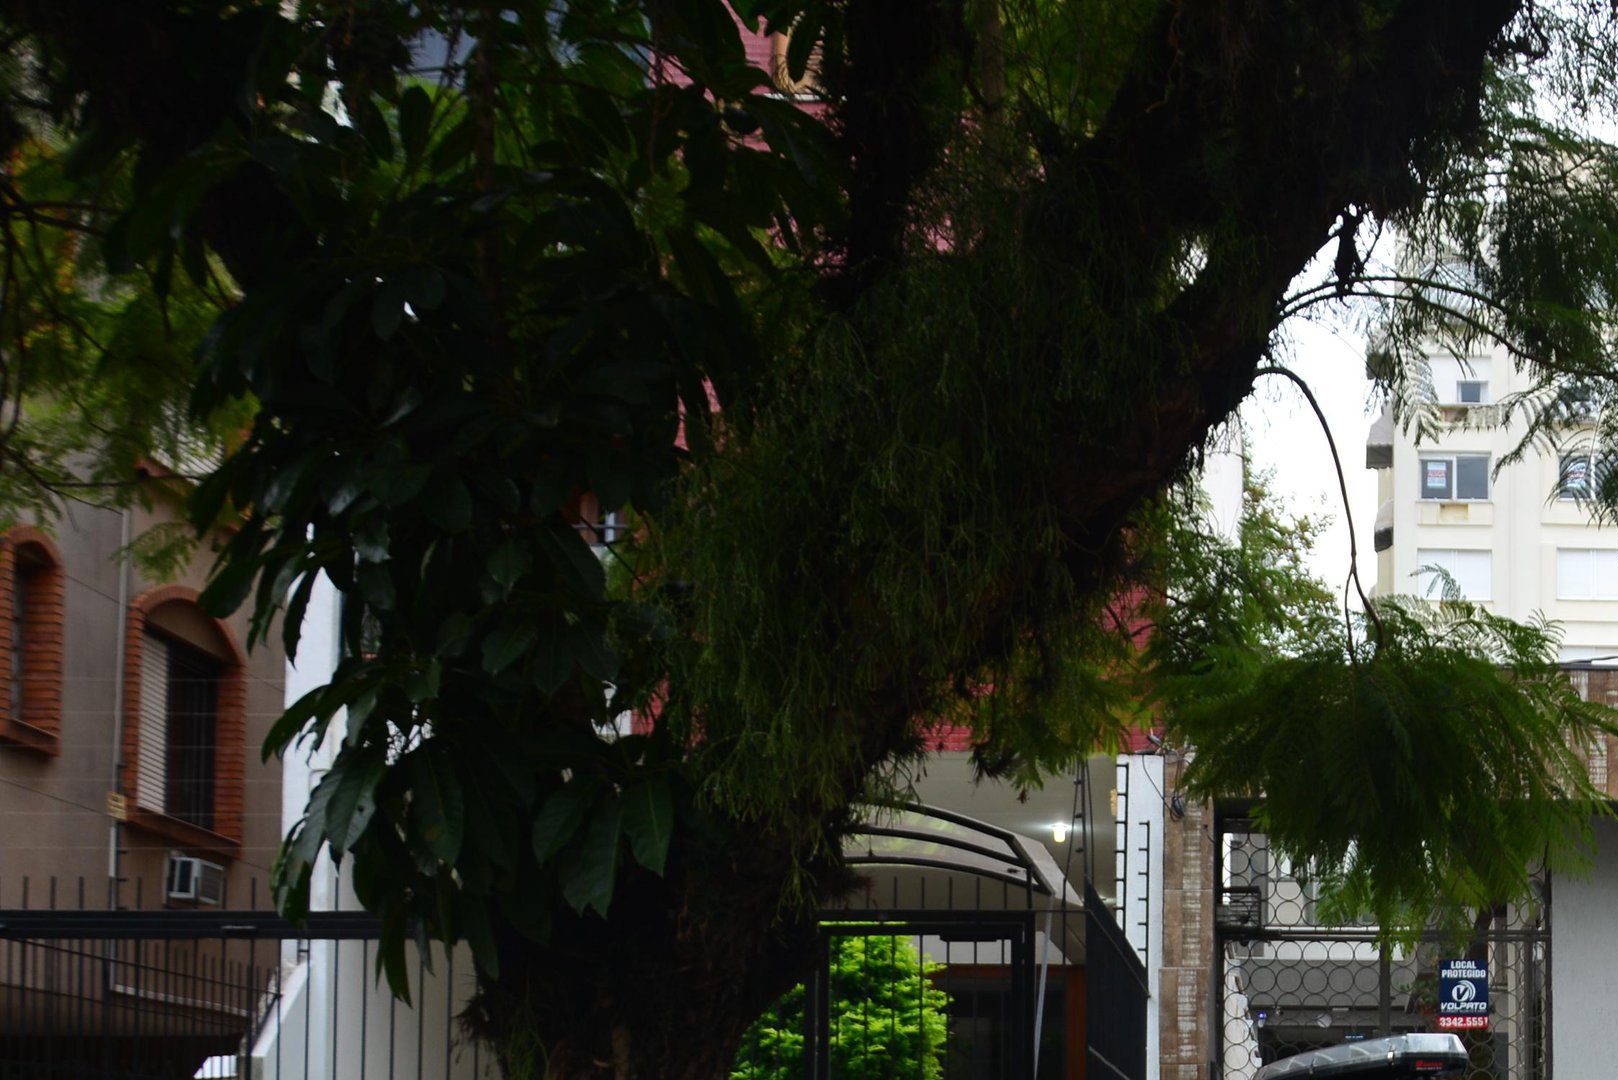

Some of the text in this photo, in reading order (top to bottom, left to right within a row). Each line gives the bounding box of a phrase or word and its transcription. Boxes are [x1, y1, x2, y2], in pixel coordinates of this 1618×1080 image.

[1451, 961, 1476, 969] LOCAL
[1442, 970, 1486, 978] PROTEGIDO
[1440, 1002, 1487, 1010] VOLPATO
[1440, 1017, 1488, 1027] 3342.5551
